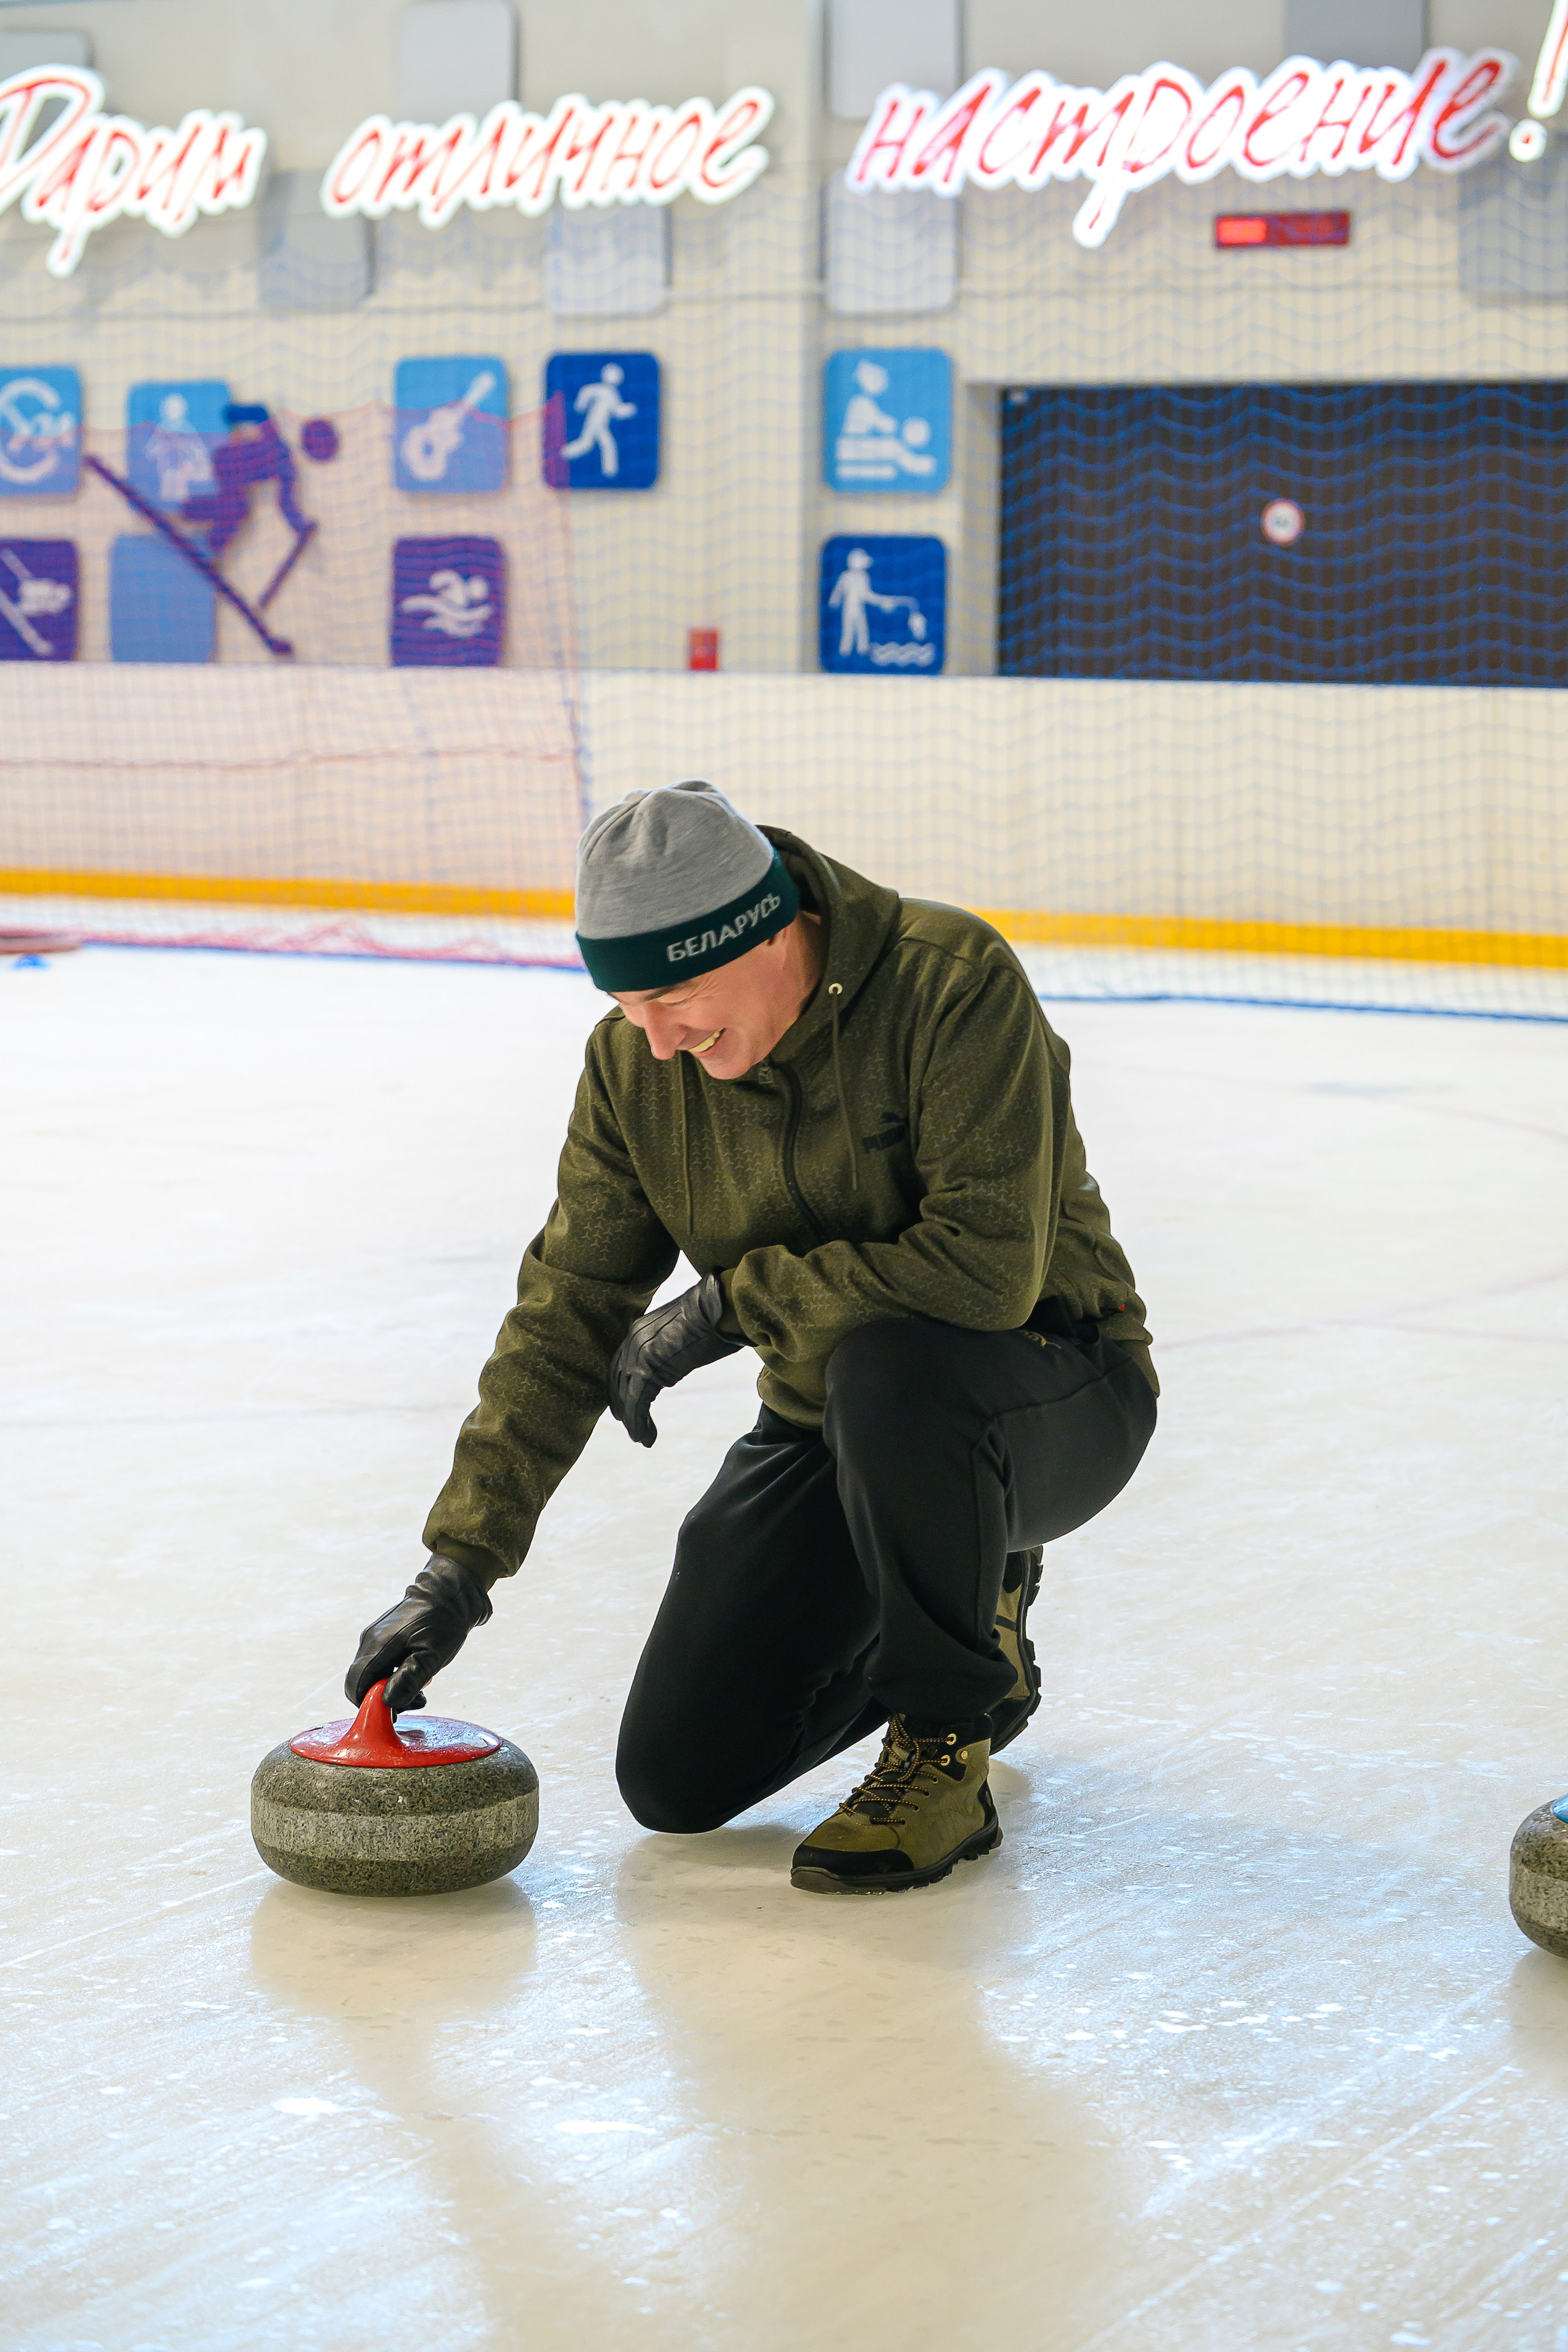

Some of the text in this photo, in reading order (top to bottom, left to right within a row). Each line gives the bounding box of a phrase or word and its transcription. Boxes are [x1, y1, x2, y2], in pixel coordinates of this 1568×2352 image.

[0, 64, 266, 275] Дарим
[320, 87, 774, 228] отличное
[666, 893, 781, 962] БЕЛАРУСЬ
